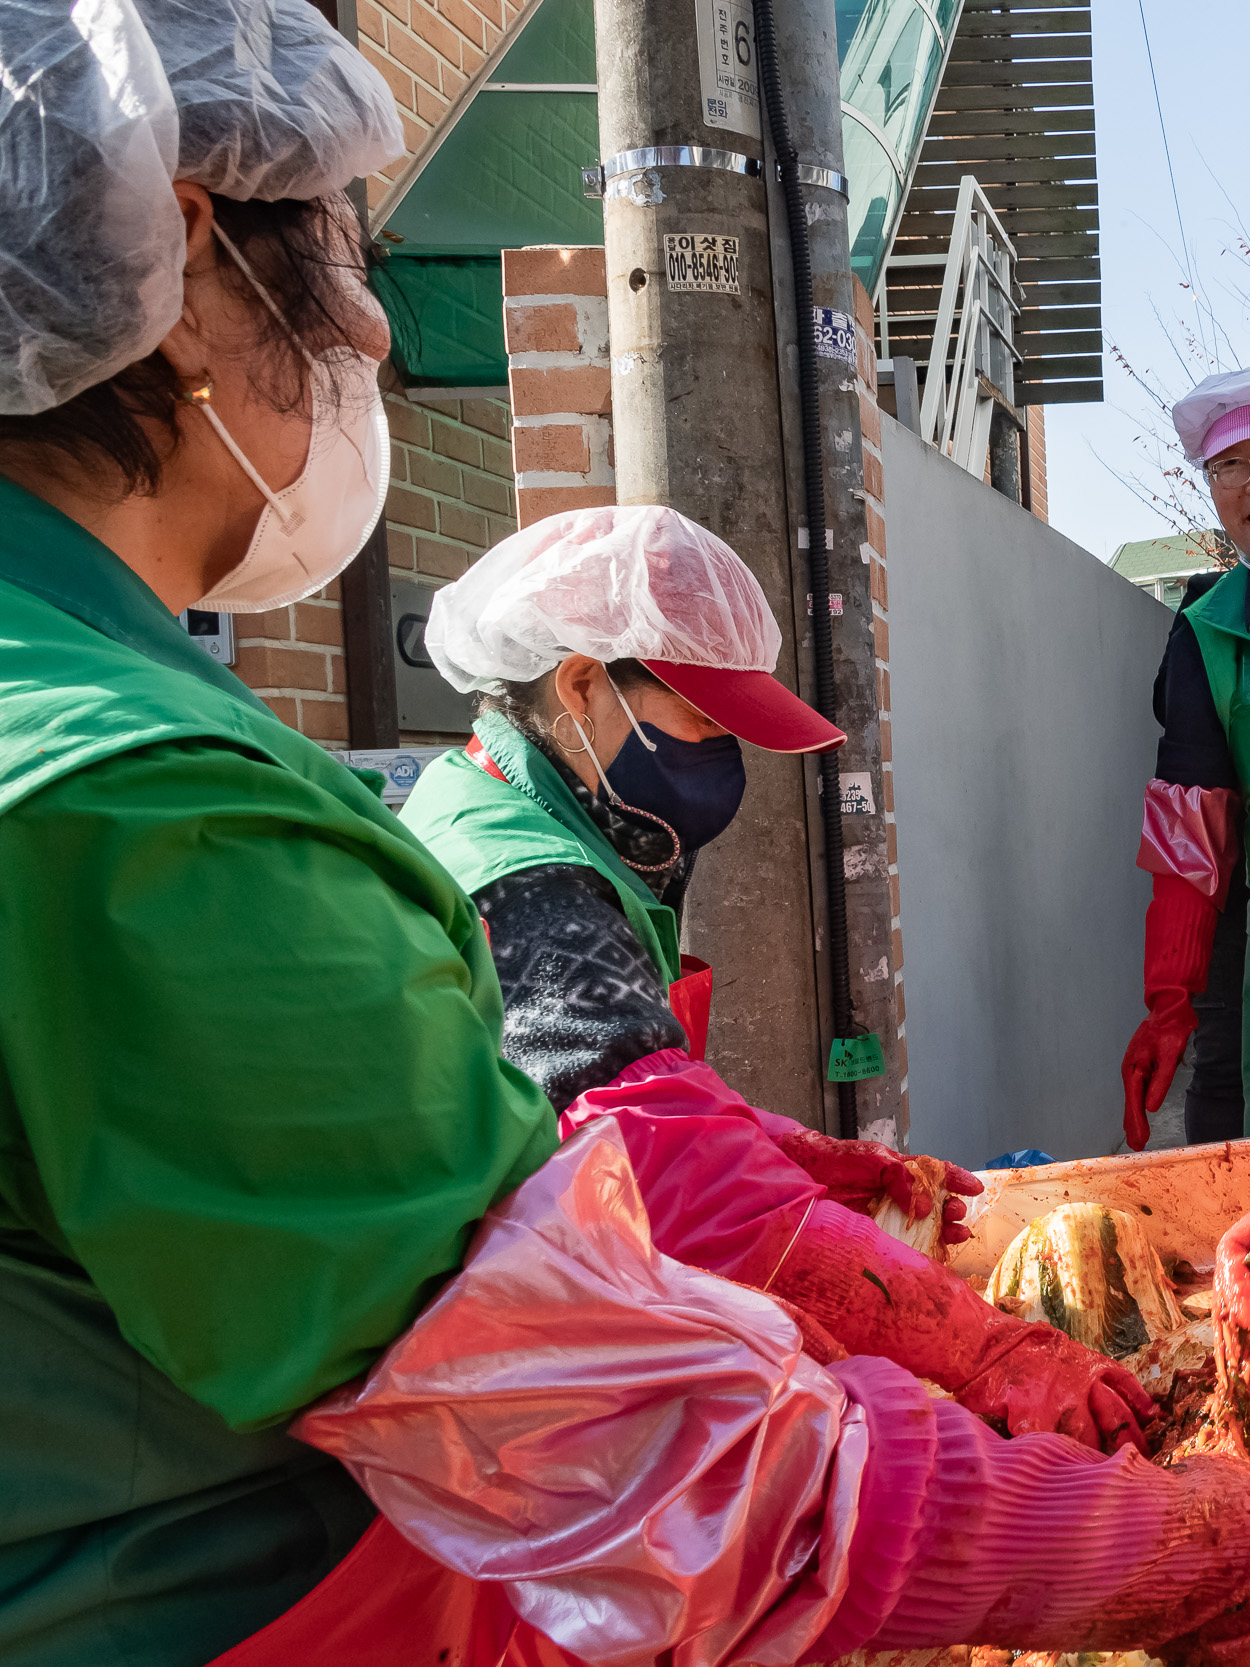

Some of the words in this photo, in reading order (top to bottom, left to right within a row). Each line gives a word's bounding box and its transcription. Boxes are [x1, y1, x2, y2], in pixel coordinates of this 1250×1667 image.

[718, 8, 730, 67] 전주번호
[707, 98, 727, 109] 문의
[708, 106, 728, 119] 전화
[678, 236, 737, 254] 이삿짐
[835, 1059, 847, 1067] SK
